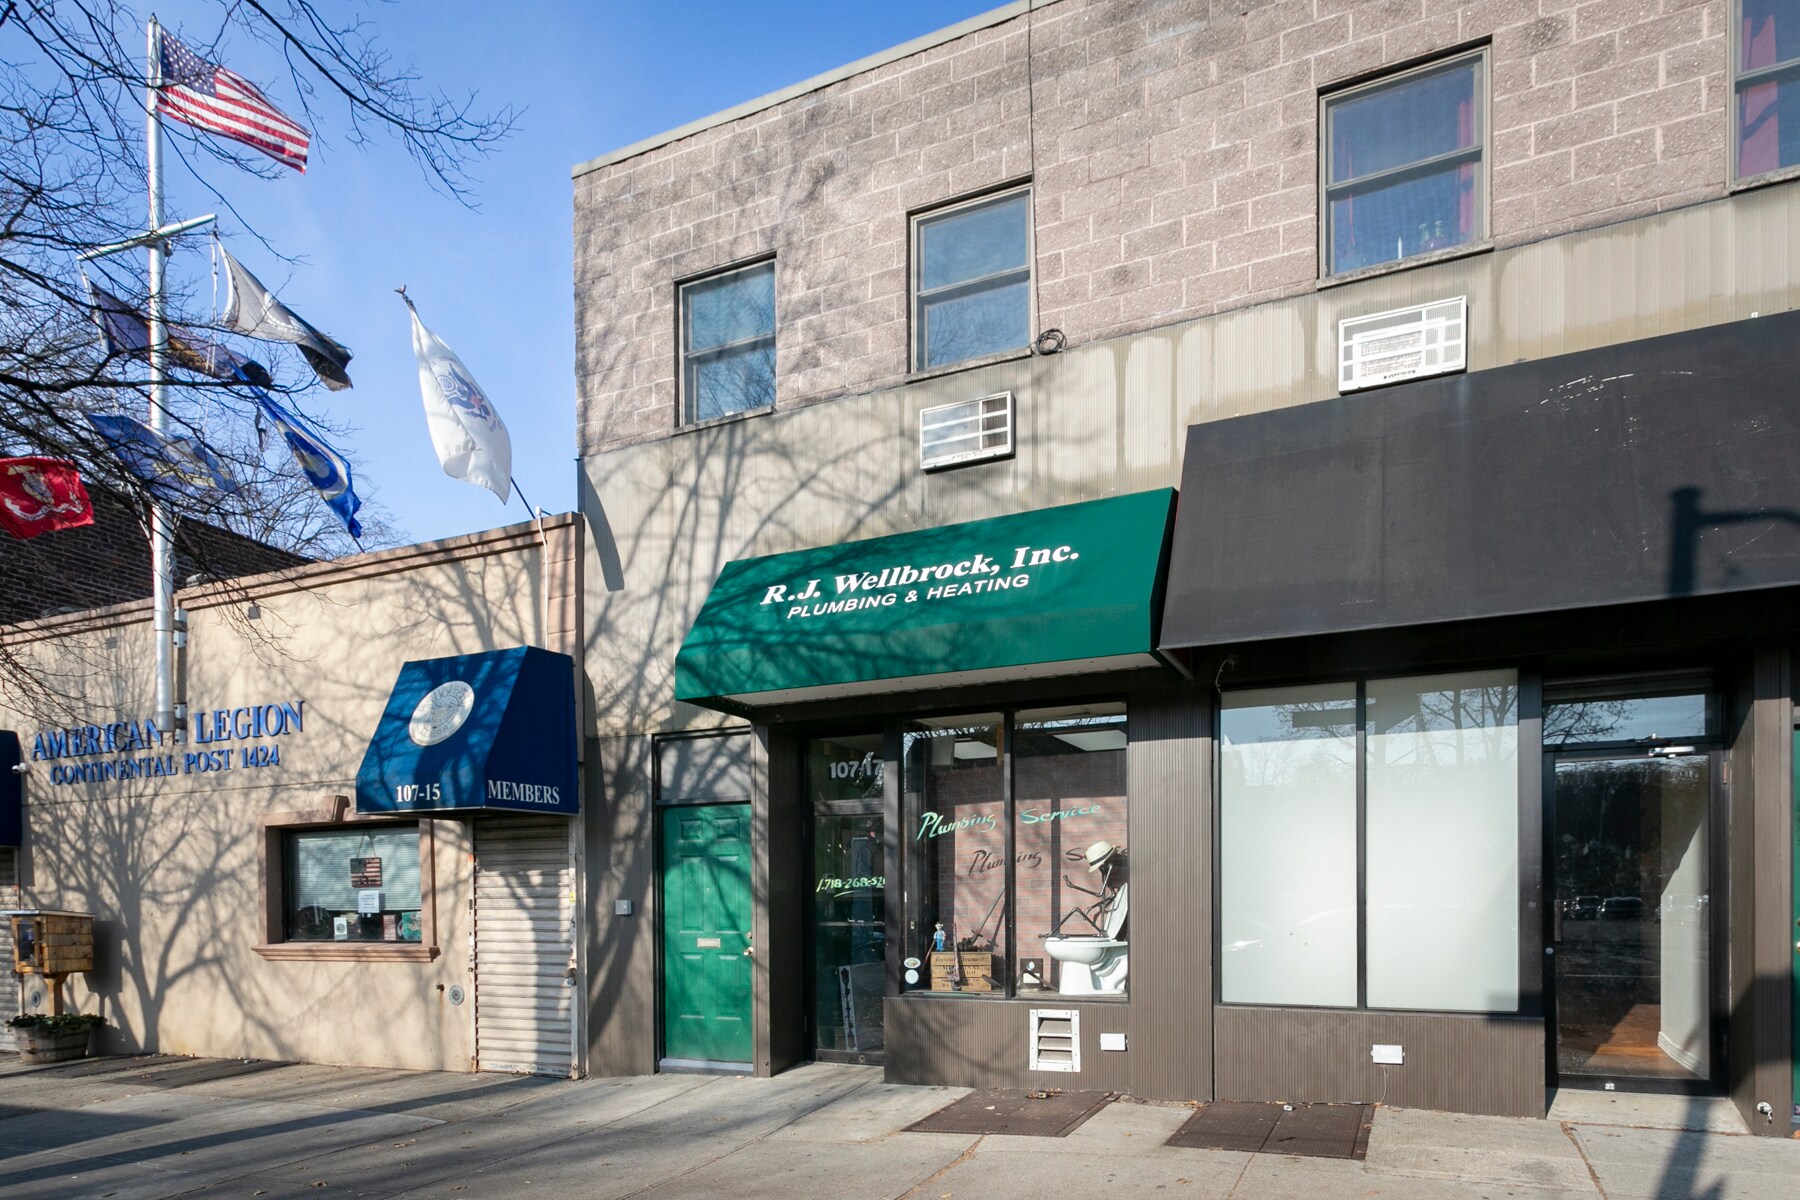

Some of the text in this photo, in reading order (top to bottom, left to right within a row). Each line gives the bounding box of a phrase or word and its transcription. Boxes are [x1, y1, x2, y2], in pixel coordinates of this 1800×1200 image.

[760, 542, 1079, 606] R.J. Wellbrock, Inc.
[787, 573, 1030, 620] PLUMBING & HEATING
[31, 699, 305, 762] AMERICAN LEGION
[50, 744, 280, 786] CONTINENTAL POST 1424
[829, 758, 884, 779] 107-17
[395, 782, 441, 803] 107-15
[487, 779, 560, 805] MEMBERS
[916, 803, 1102, 841] Plumbing Service
